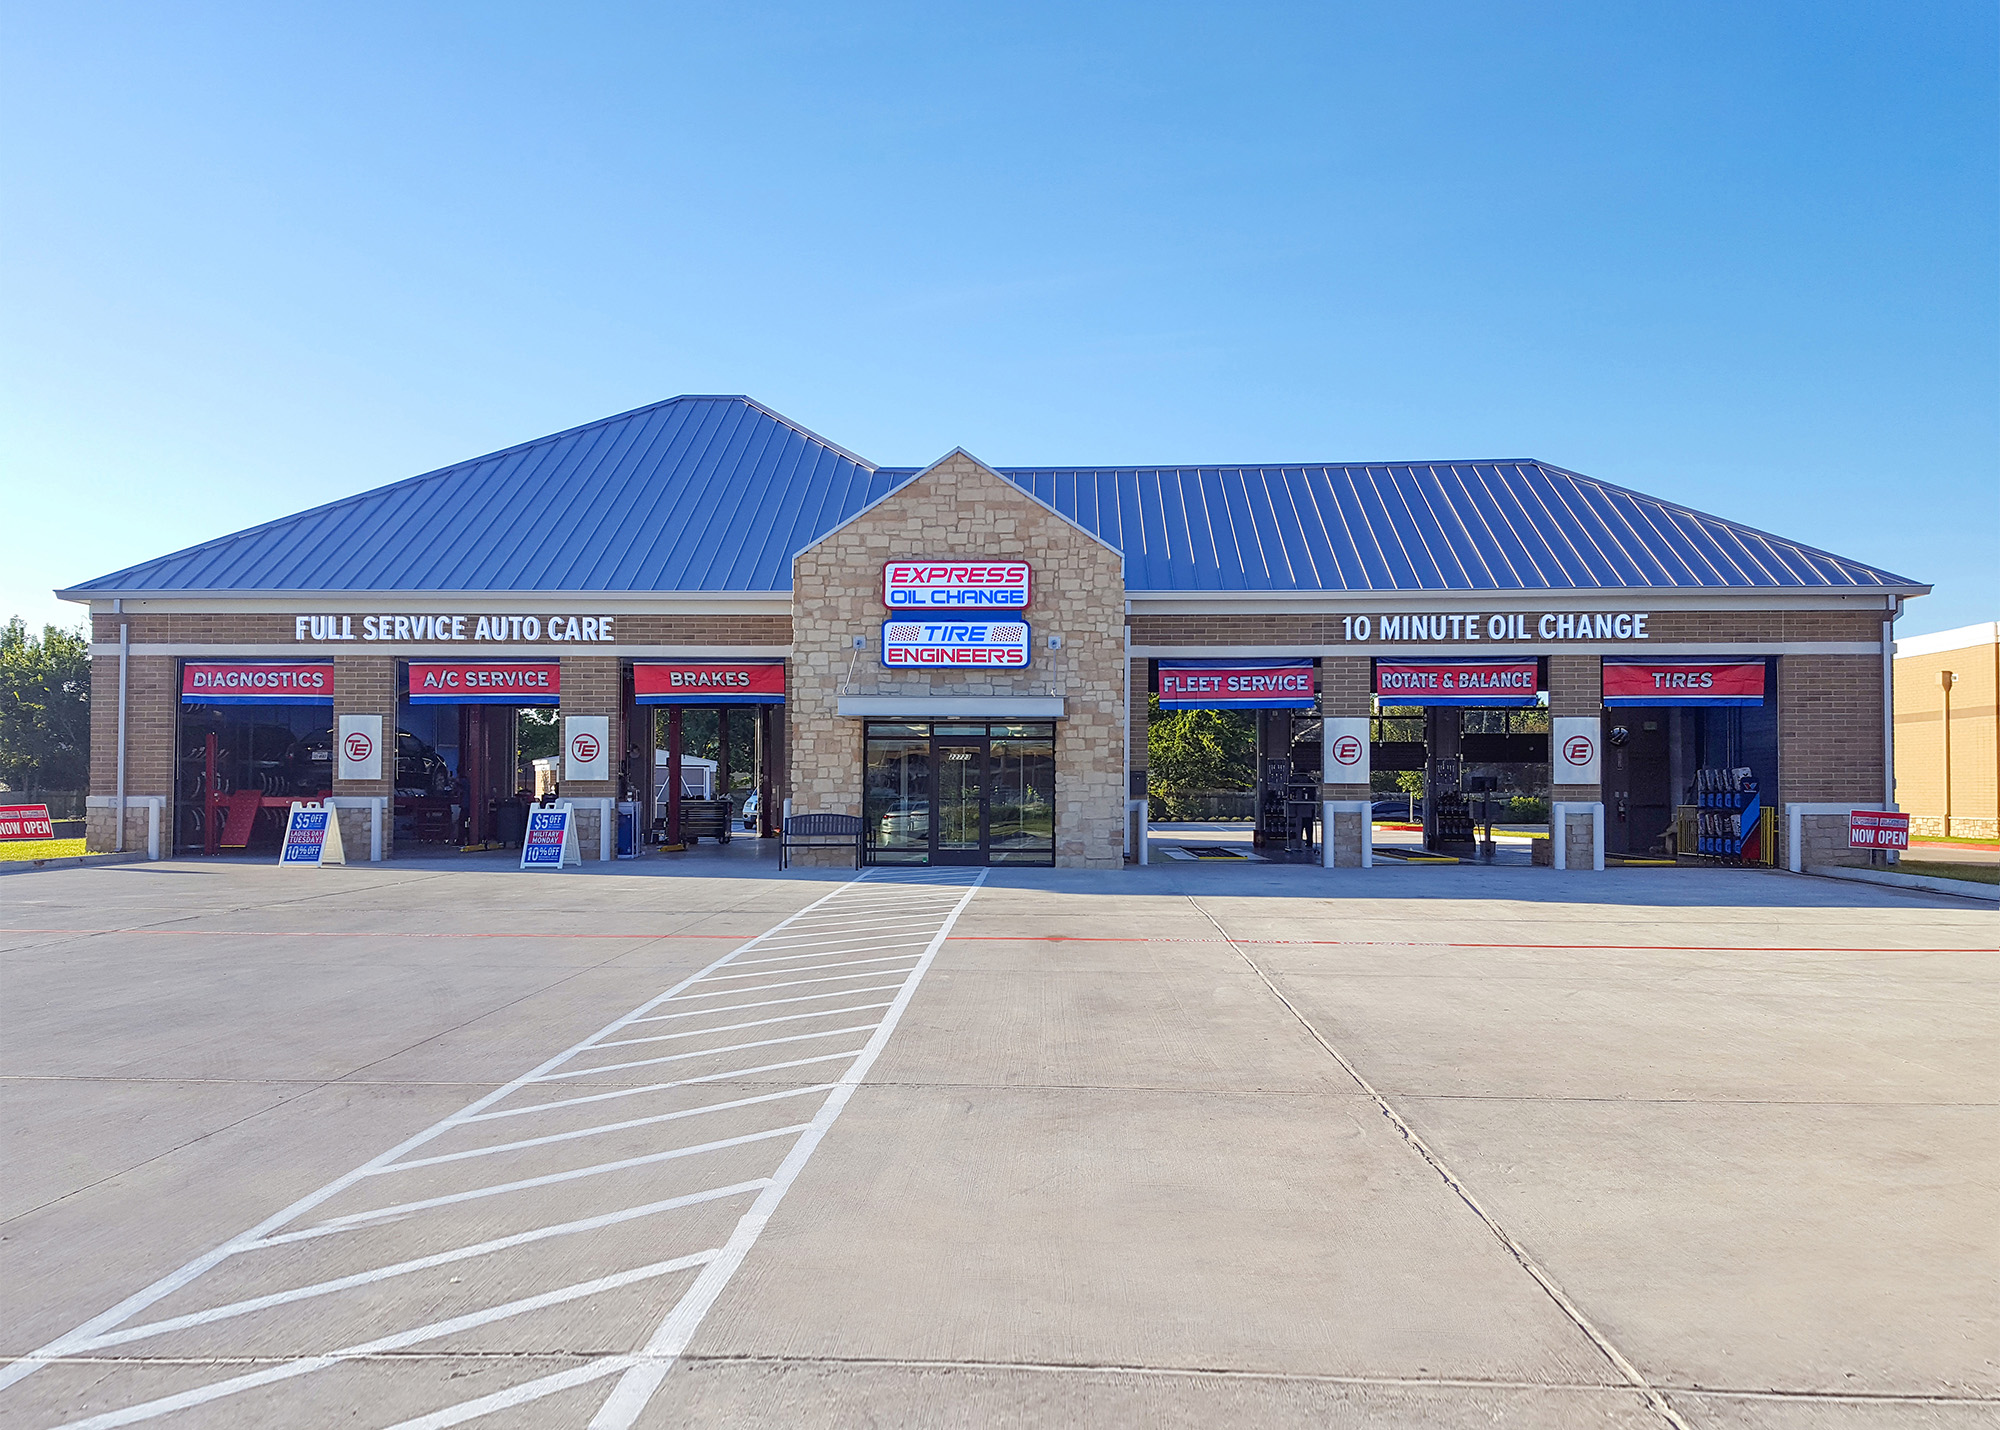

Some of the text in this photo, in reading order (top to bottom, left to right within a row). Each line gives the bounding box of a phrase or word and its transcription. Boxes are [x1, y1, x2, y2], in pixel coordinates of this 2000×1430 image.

[891, 567, 1026, 583] EXPRESS
[890, 590, 1024, 604] OIL CHANGE
[295, 615, 615, 641] FULL SERVICE AUTO CARE
[924, 626, 988, 642] TIRE
[1342, 613, 1649, 641] 10 MINUTE OIL CHANGE
[888, 648, 1023, 663] ENGINEERS
[193, 671, 325, 688] DIAGNOSTICS
[423, 669, 549, 689] A/C SERVICE
[669, 671, 751, 687] BRAKES
[1163, 674, 1309, 692] FLEET SERVICE
[1381, 671, 1533, 689] ROTATE & BALANCE
[1651, 672, 1713, 689] TIRES
[348, 740, 369, 756] TE
[575, 740, 597, 757] TE
[0, 820, 50, 834] NOW OPEN
[295, 813, 323, 829] $5 OFF
[534, 813, 561, 830] $5 OFF
[1852, 828, 1906, 845] NOW OPEN
